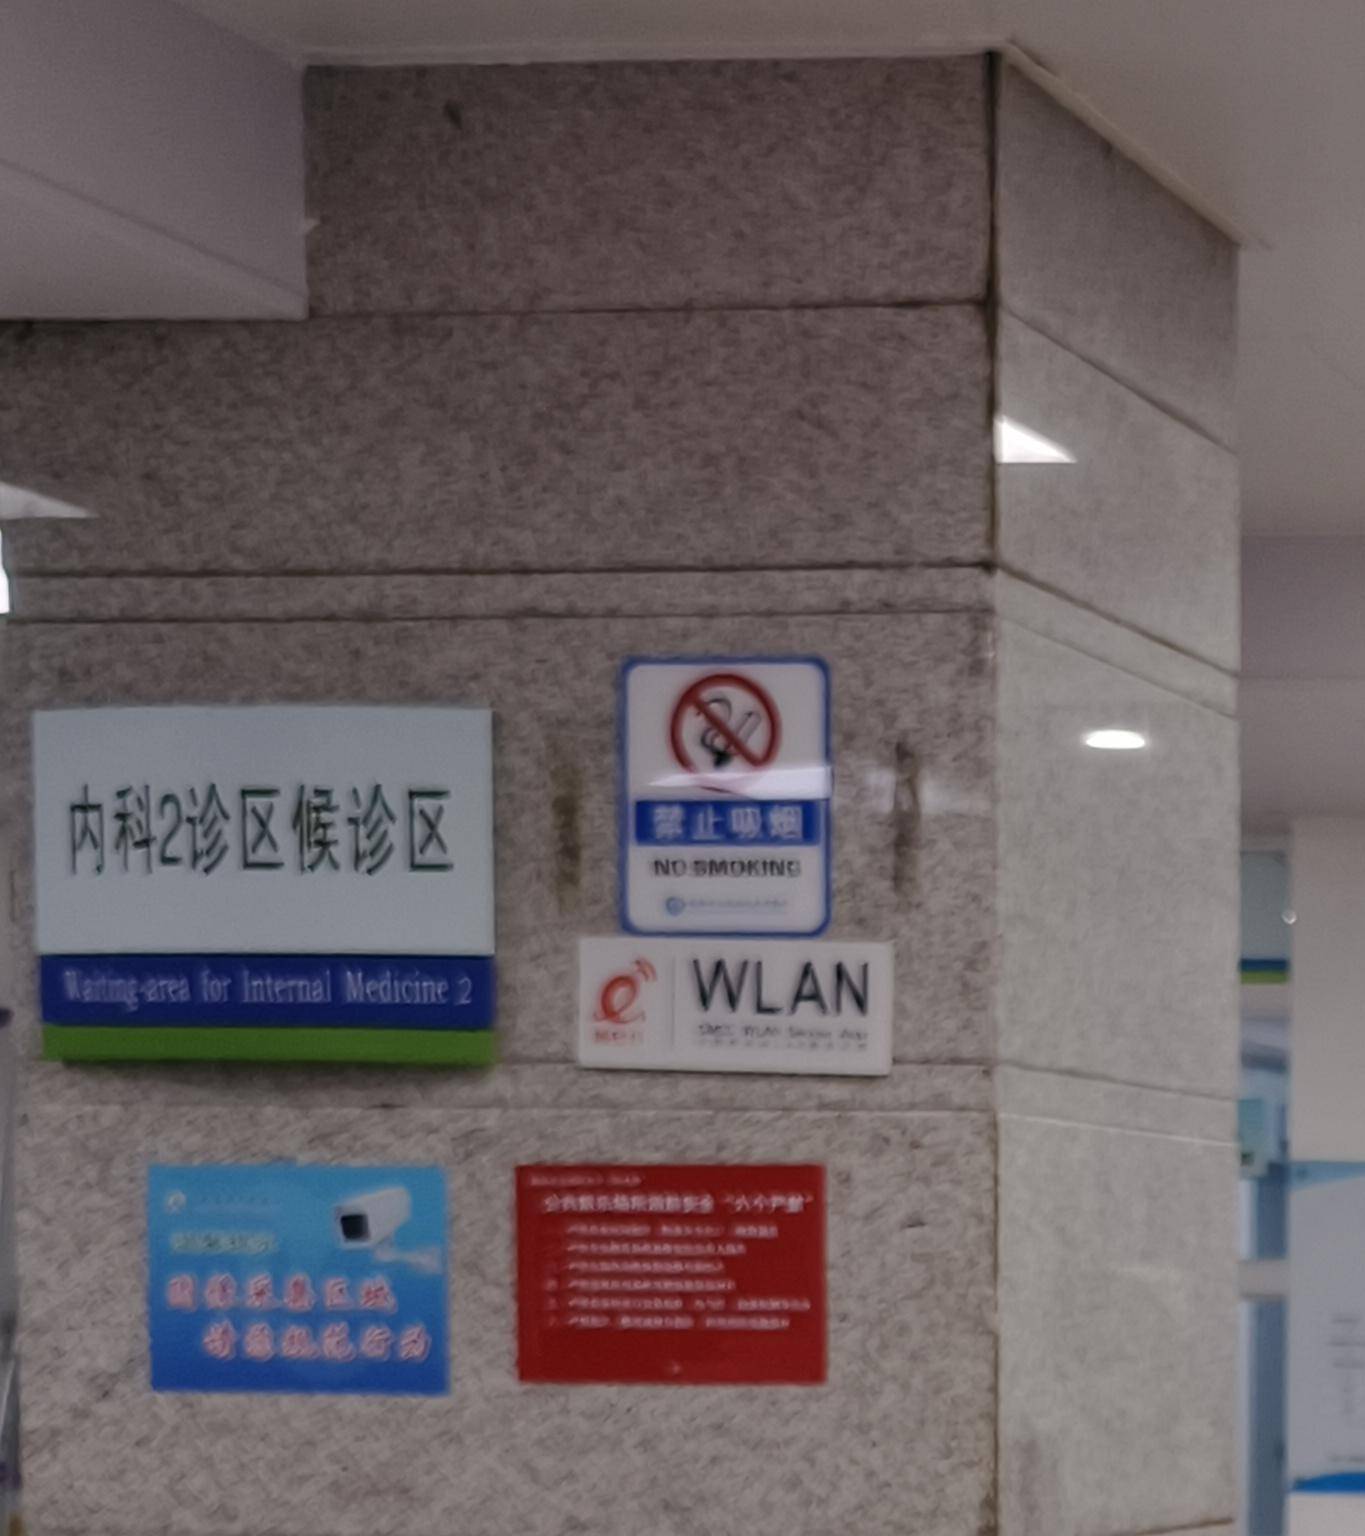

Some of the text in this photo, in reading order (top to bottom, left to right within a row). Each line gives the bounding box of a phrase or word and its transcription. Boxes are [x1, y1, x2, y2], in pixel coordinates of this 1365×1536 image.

[67, 783, 455, 876] 内科2诊区候诊区
[652, 804, 804, 841] 禁止吸烟
[652, 857, 802, 878] NO SMOKING
[201, 966, 232, 1003] for
[241, 967, 333, 1004] Internal
[345, 968, 450, 1006] Medicine
[453, 975, 473, 1007] 2
[692, 957, 870, 1018] WLAN
